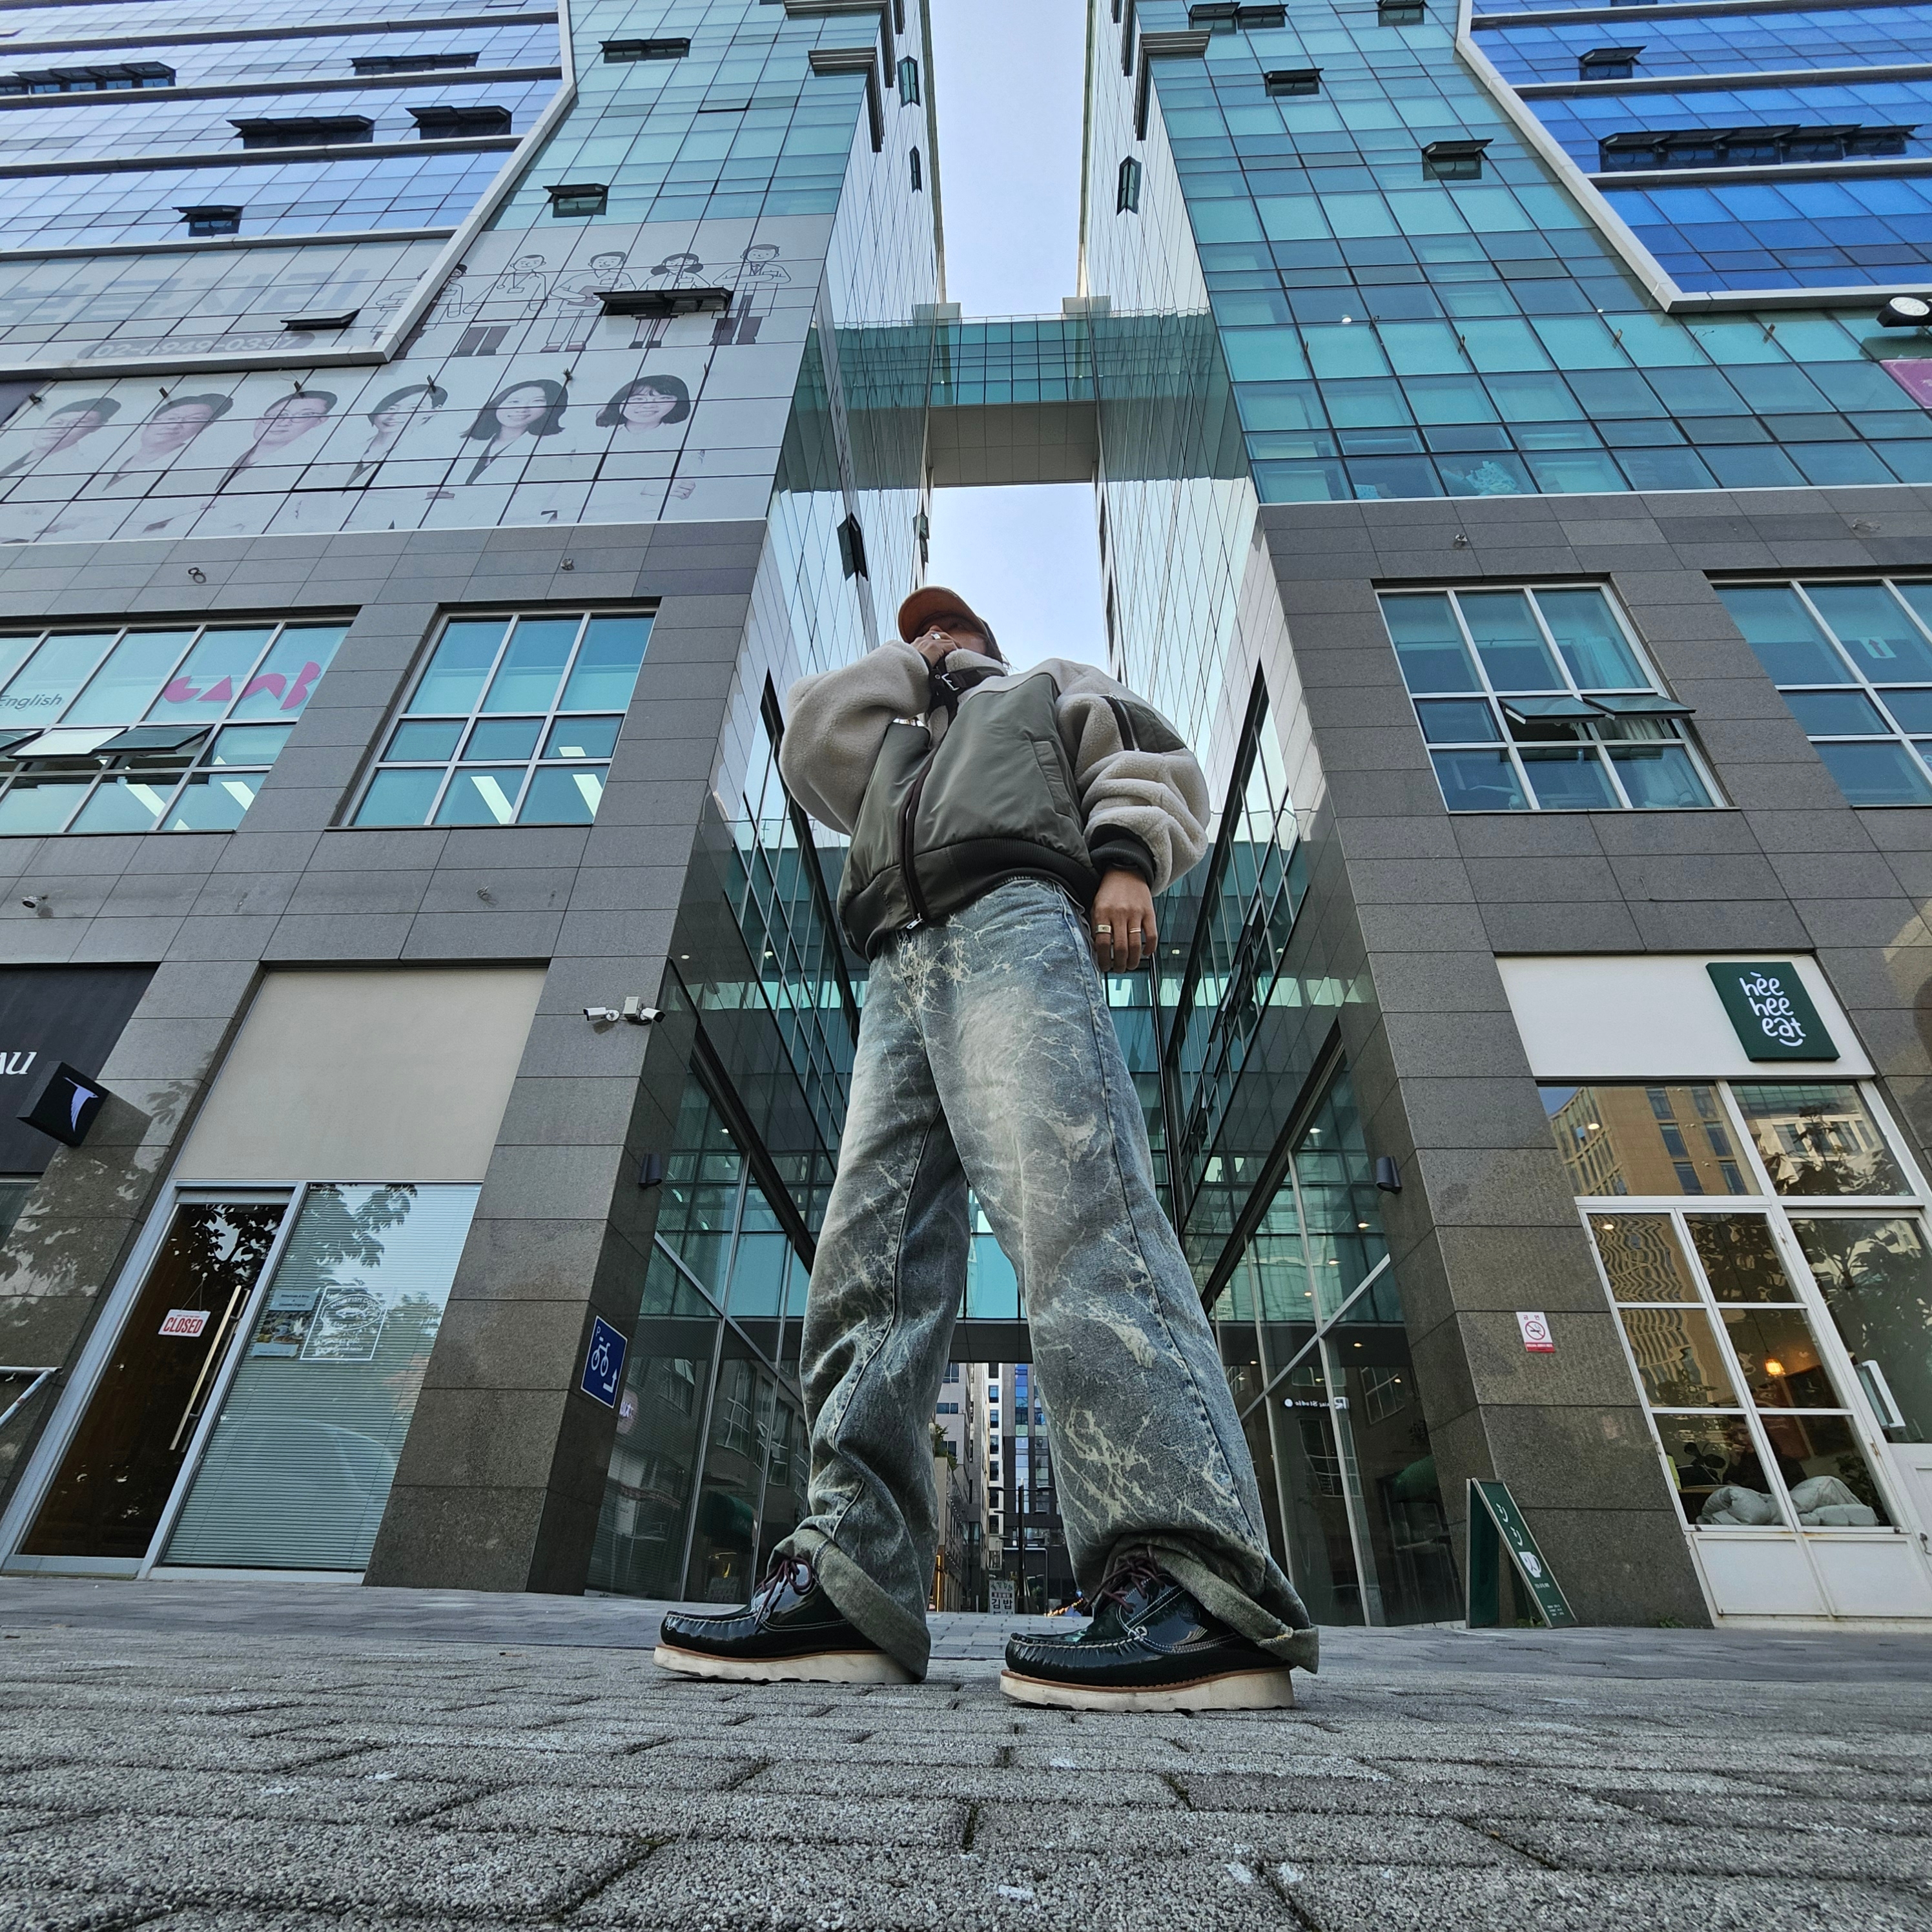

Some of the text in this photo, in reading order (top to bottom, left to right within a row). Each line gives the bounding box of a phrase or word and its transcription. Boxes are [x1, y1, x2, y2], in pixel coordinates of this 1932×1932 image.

[92, 334, 302, 357] 02-6949-0337
[0, 694, 63, 710] English
[1748, 997, 1794, 1016] hee
[1762, 1017, 1806, 1038] eat
[0, 1051, 37, 1075] U
[163, 1317, 203, 1333] CLOSED
[595, 1326, 601, 1337] P
[991, 1598, 1013, 1610] 김밥
